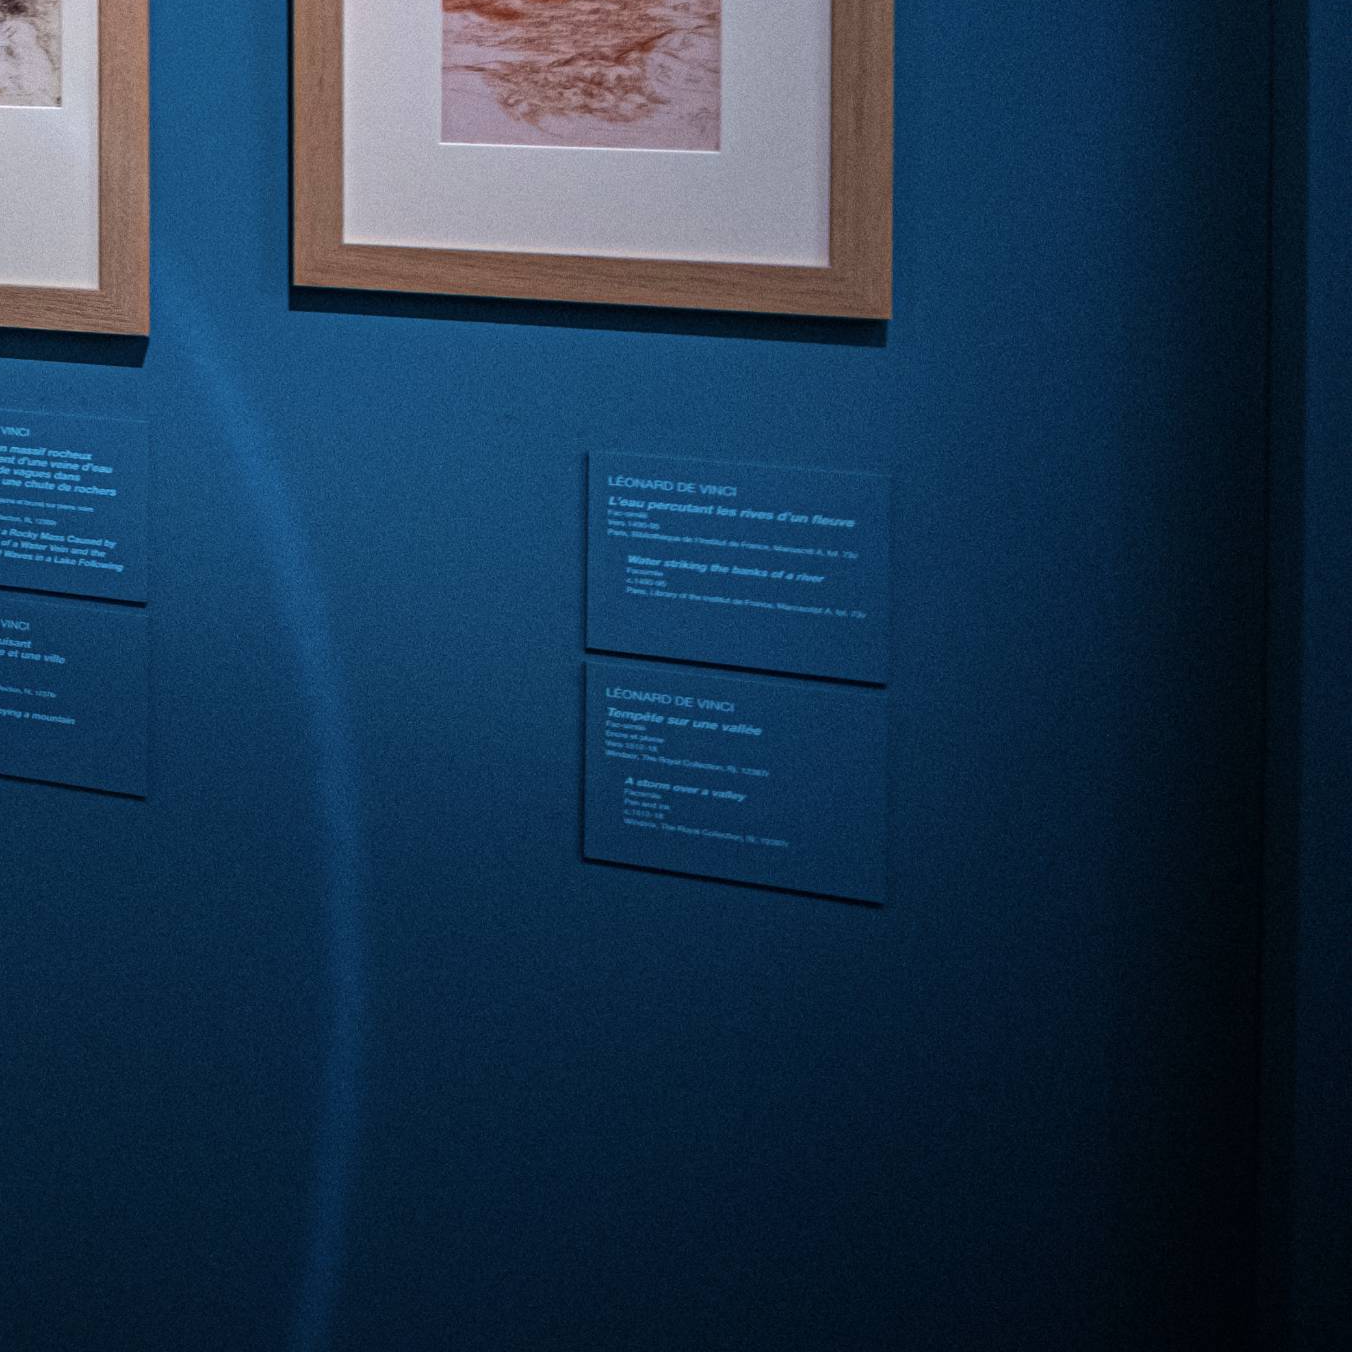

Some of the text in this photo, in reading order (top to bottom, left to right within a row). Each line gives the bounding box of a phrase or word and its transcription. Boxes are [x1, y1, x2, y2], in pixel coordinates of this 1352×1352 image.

[0, 426, 30, 437] VINCI
[48, 450, 92, 460] rocheux
[50, 461, 80, 470] veine
[13, 469, 51, 479] vagues
[53, 471, 81, 481] dans
[1, 478, 22, 487] une
[24, 480, 55, 490] chute
[57, 483, 72, 492] de
[73, 486, 117, 497] rochers
[676, 482, 696, 493] DE
[698, 484, 737, 497] VINCI
[647, 501, 714, 515] percutant
[715, 506, 737, 517] les
[739, 509, 774, 520] rives
[812, 514, 856, 528] fleuve
[0, 618, 30, 631] VINCI
[7, 649, 19, 658] et
[20, 652, 41, 661] une
[43, 654, 66, 665] ville
[674, 695, 694, 708] DE
[697, 698, 736, 712] VINCI
[667, 716, 690, 726] sur
[692, 720, 719, 730] une
[722, 723, 763, 736] vallée
